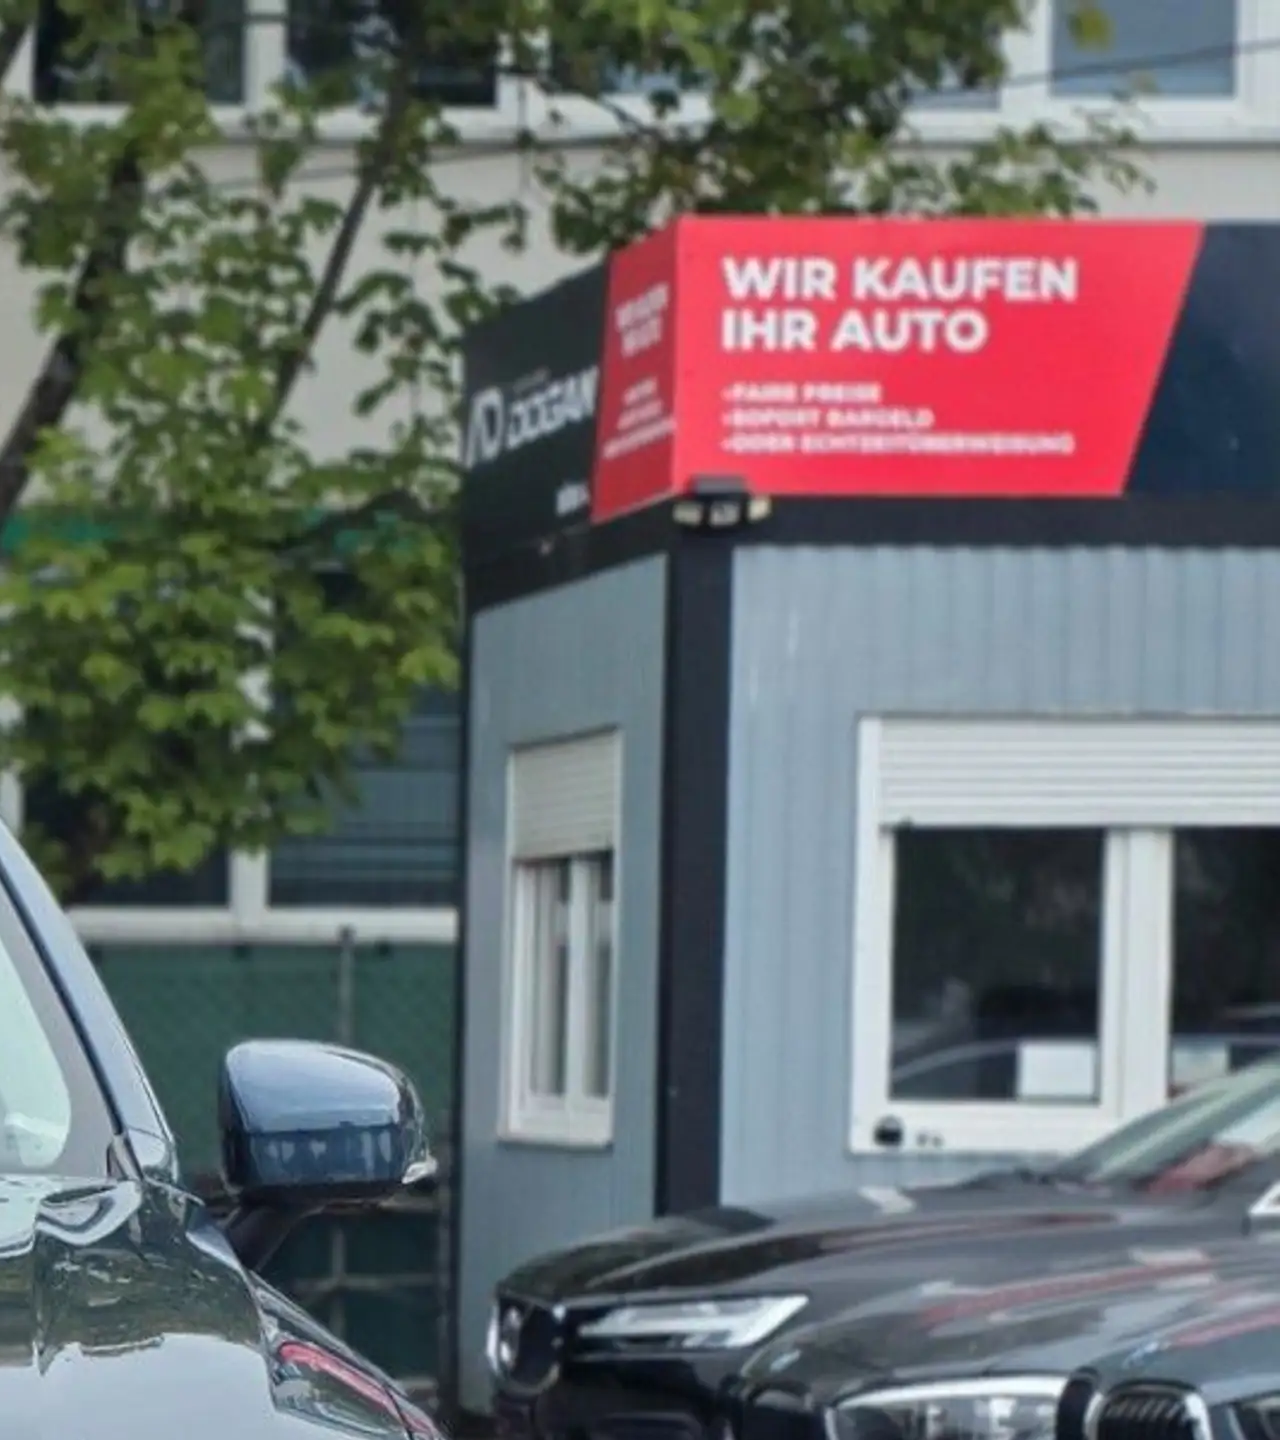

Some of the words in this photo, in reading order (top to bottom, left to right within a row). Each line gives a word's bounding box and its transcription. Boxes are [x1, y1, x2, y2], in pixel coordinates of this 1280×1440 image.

[721, 255, 839, 301] WIR
[852, 255, 1080, 302] KAUFEN
[721, 307, 818, 352] IHR
[830, 307, 989, 353] AUTO
